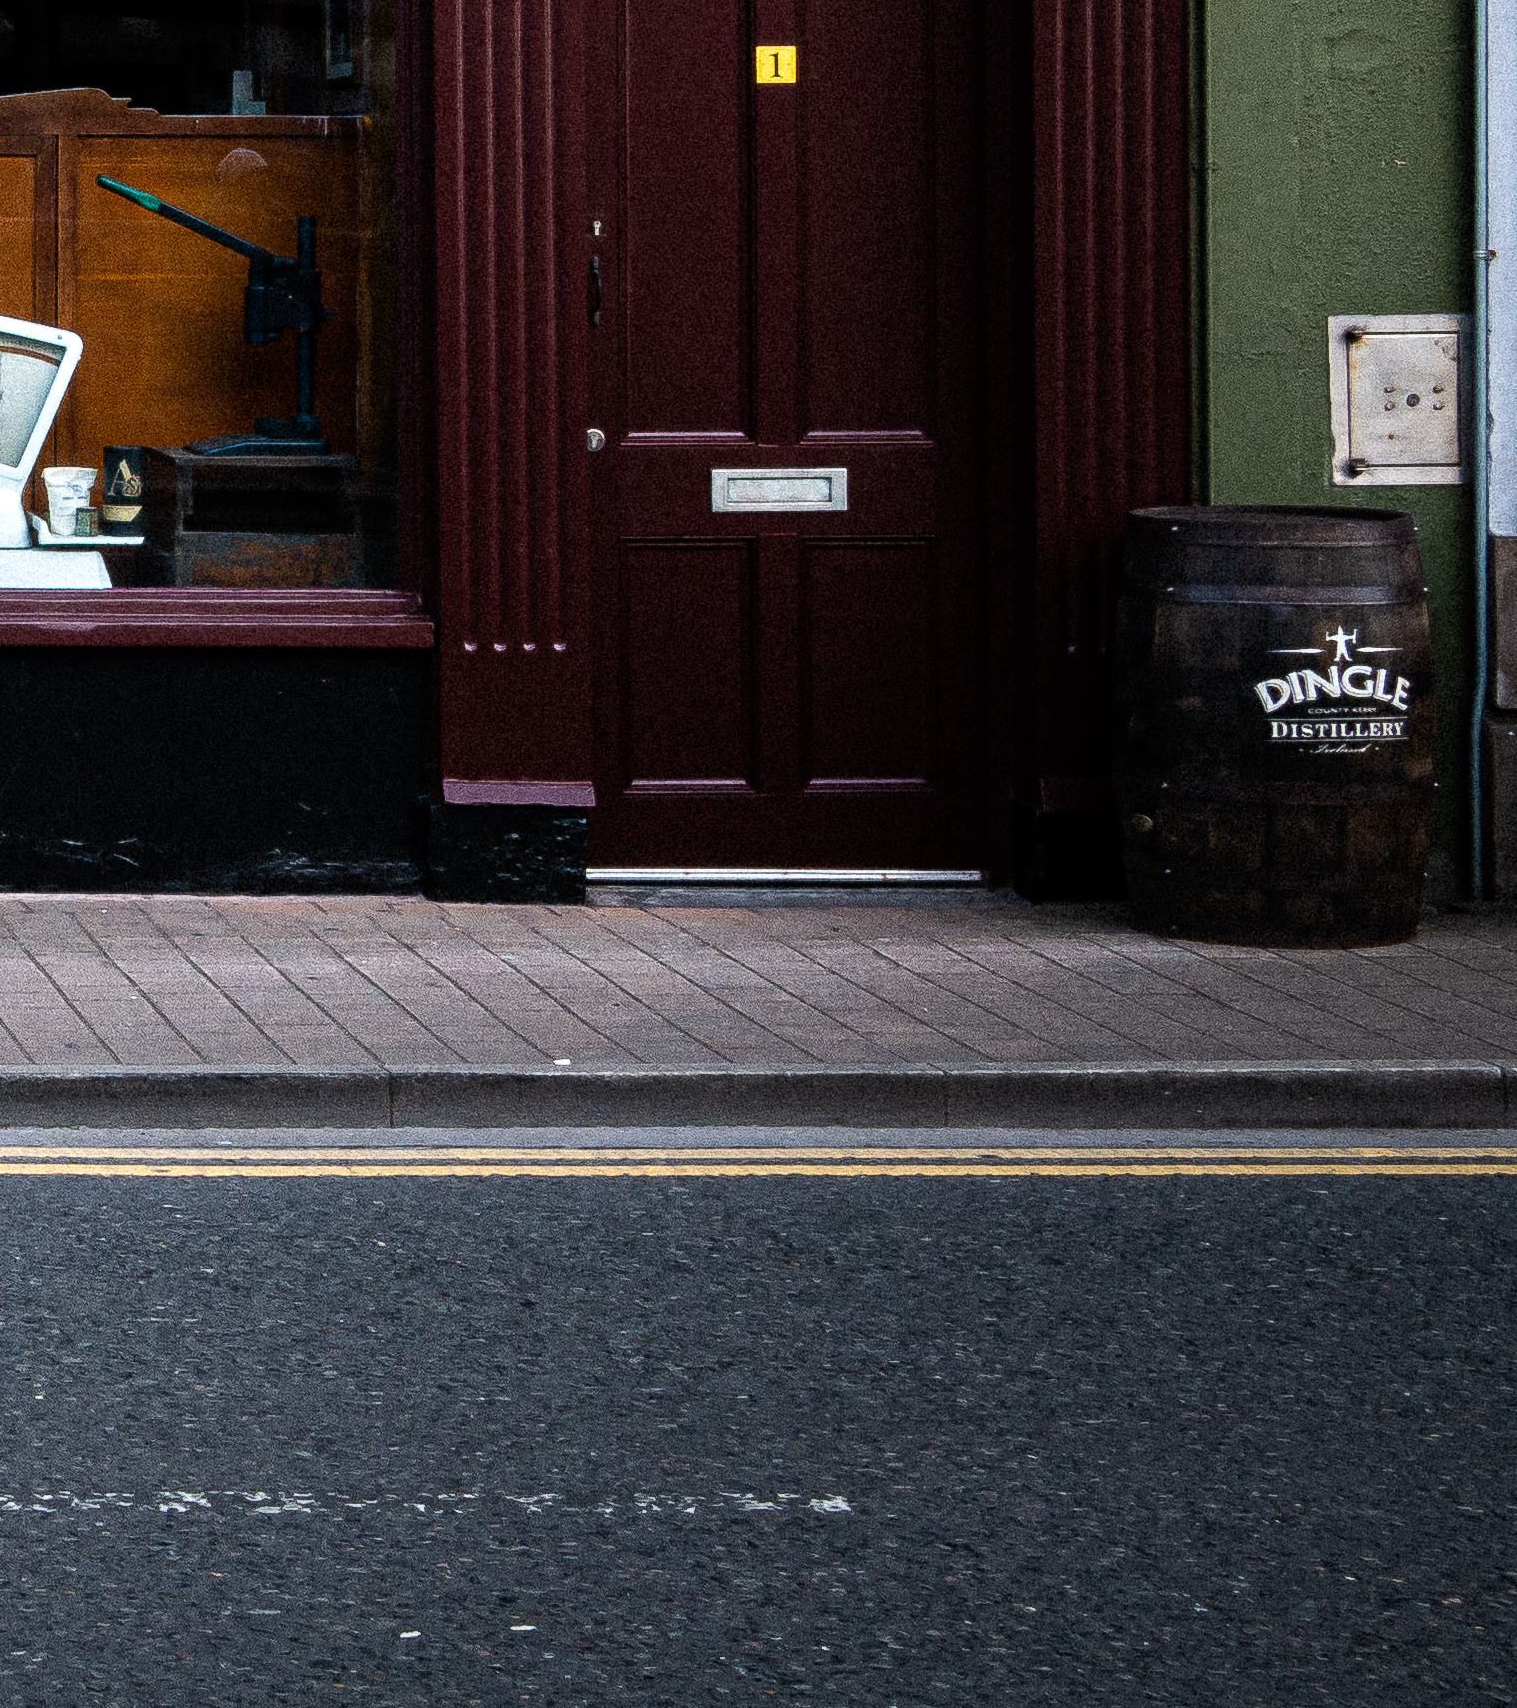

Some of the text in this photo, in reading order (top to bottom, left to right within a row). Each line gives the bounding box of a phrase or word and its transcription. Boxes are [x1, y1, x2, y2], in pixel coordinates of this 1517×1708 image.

[768, 52, 784, 79] 1
[1253, 665, 1411, 713] DINGLE
[1270, 721, 1405, 738] DISTILLERY
